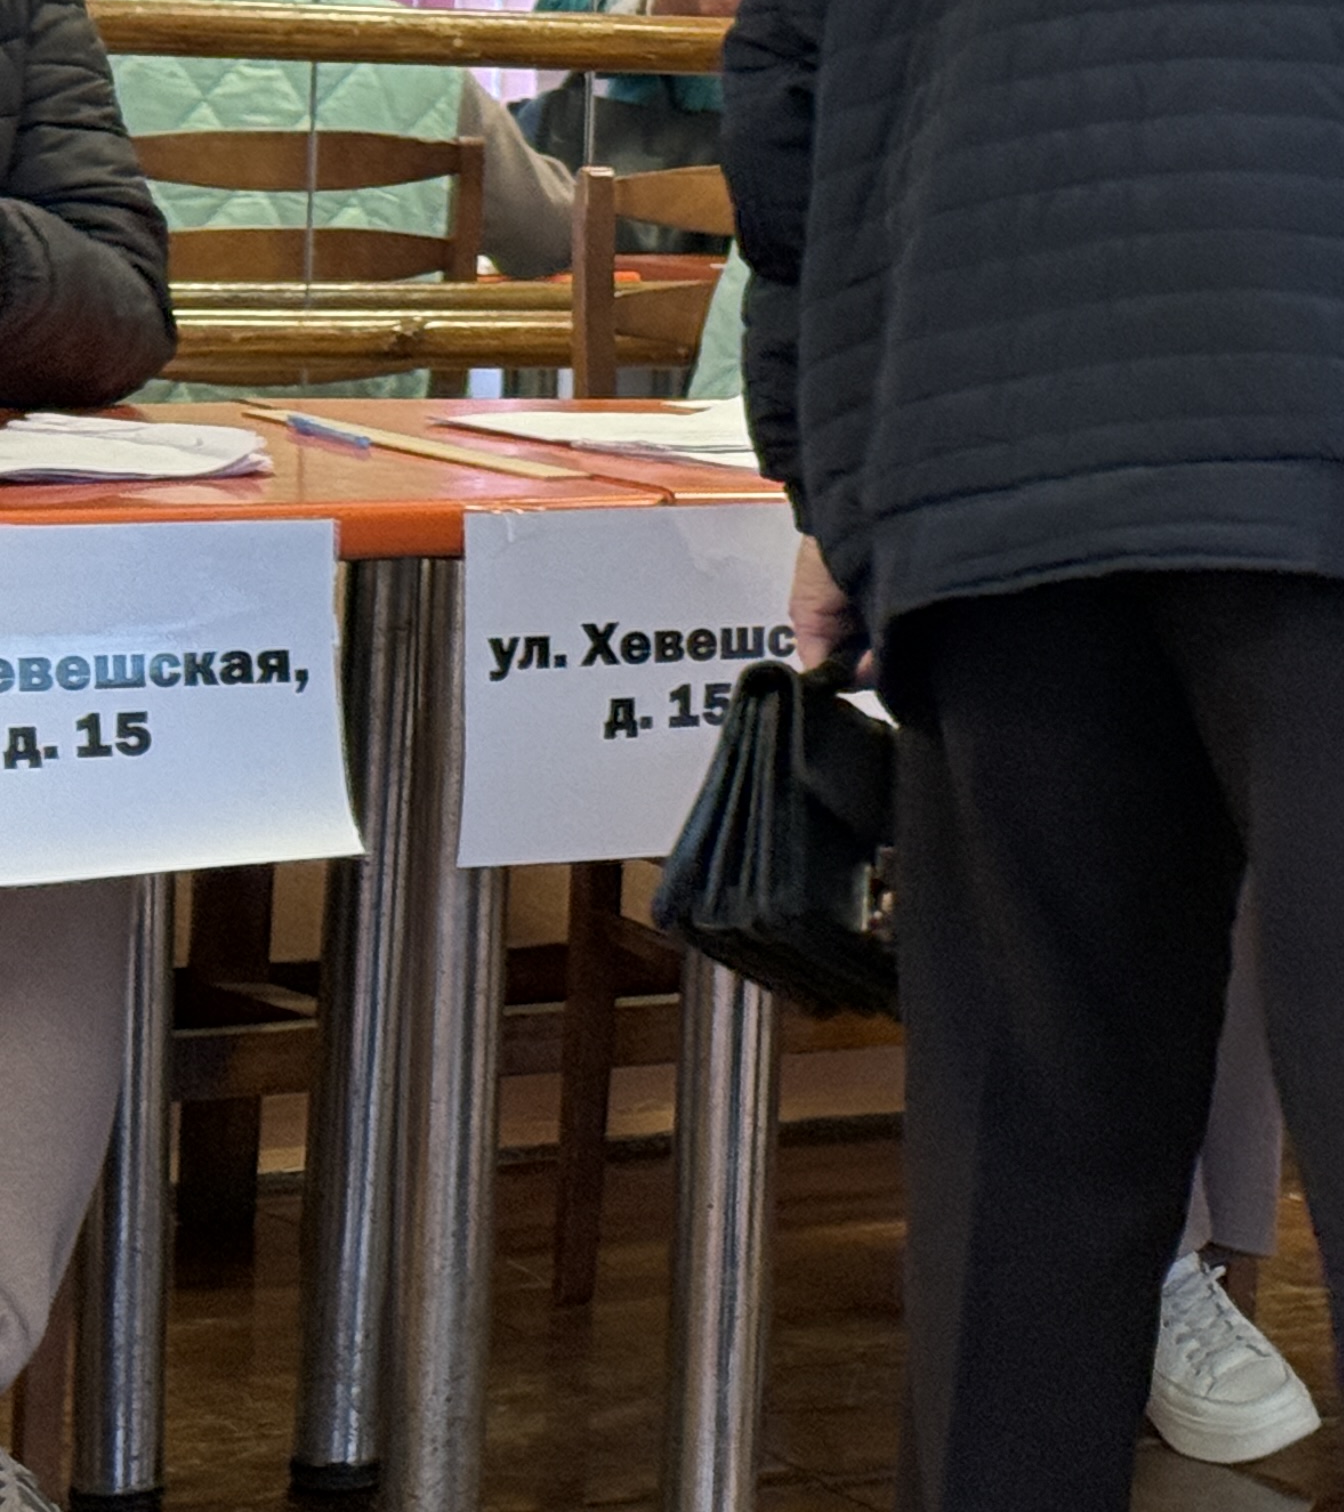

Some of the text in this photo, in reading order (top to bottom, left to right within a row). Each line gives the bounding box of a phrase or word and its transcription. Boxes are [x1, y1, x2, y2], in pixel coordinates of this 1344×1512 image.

[488, 635, 568, 682] ул.
[3, 711, 152, 770] д. 15
[603, 697, 653, 740] д.
